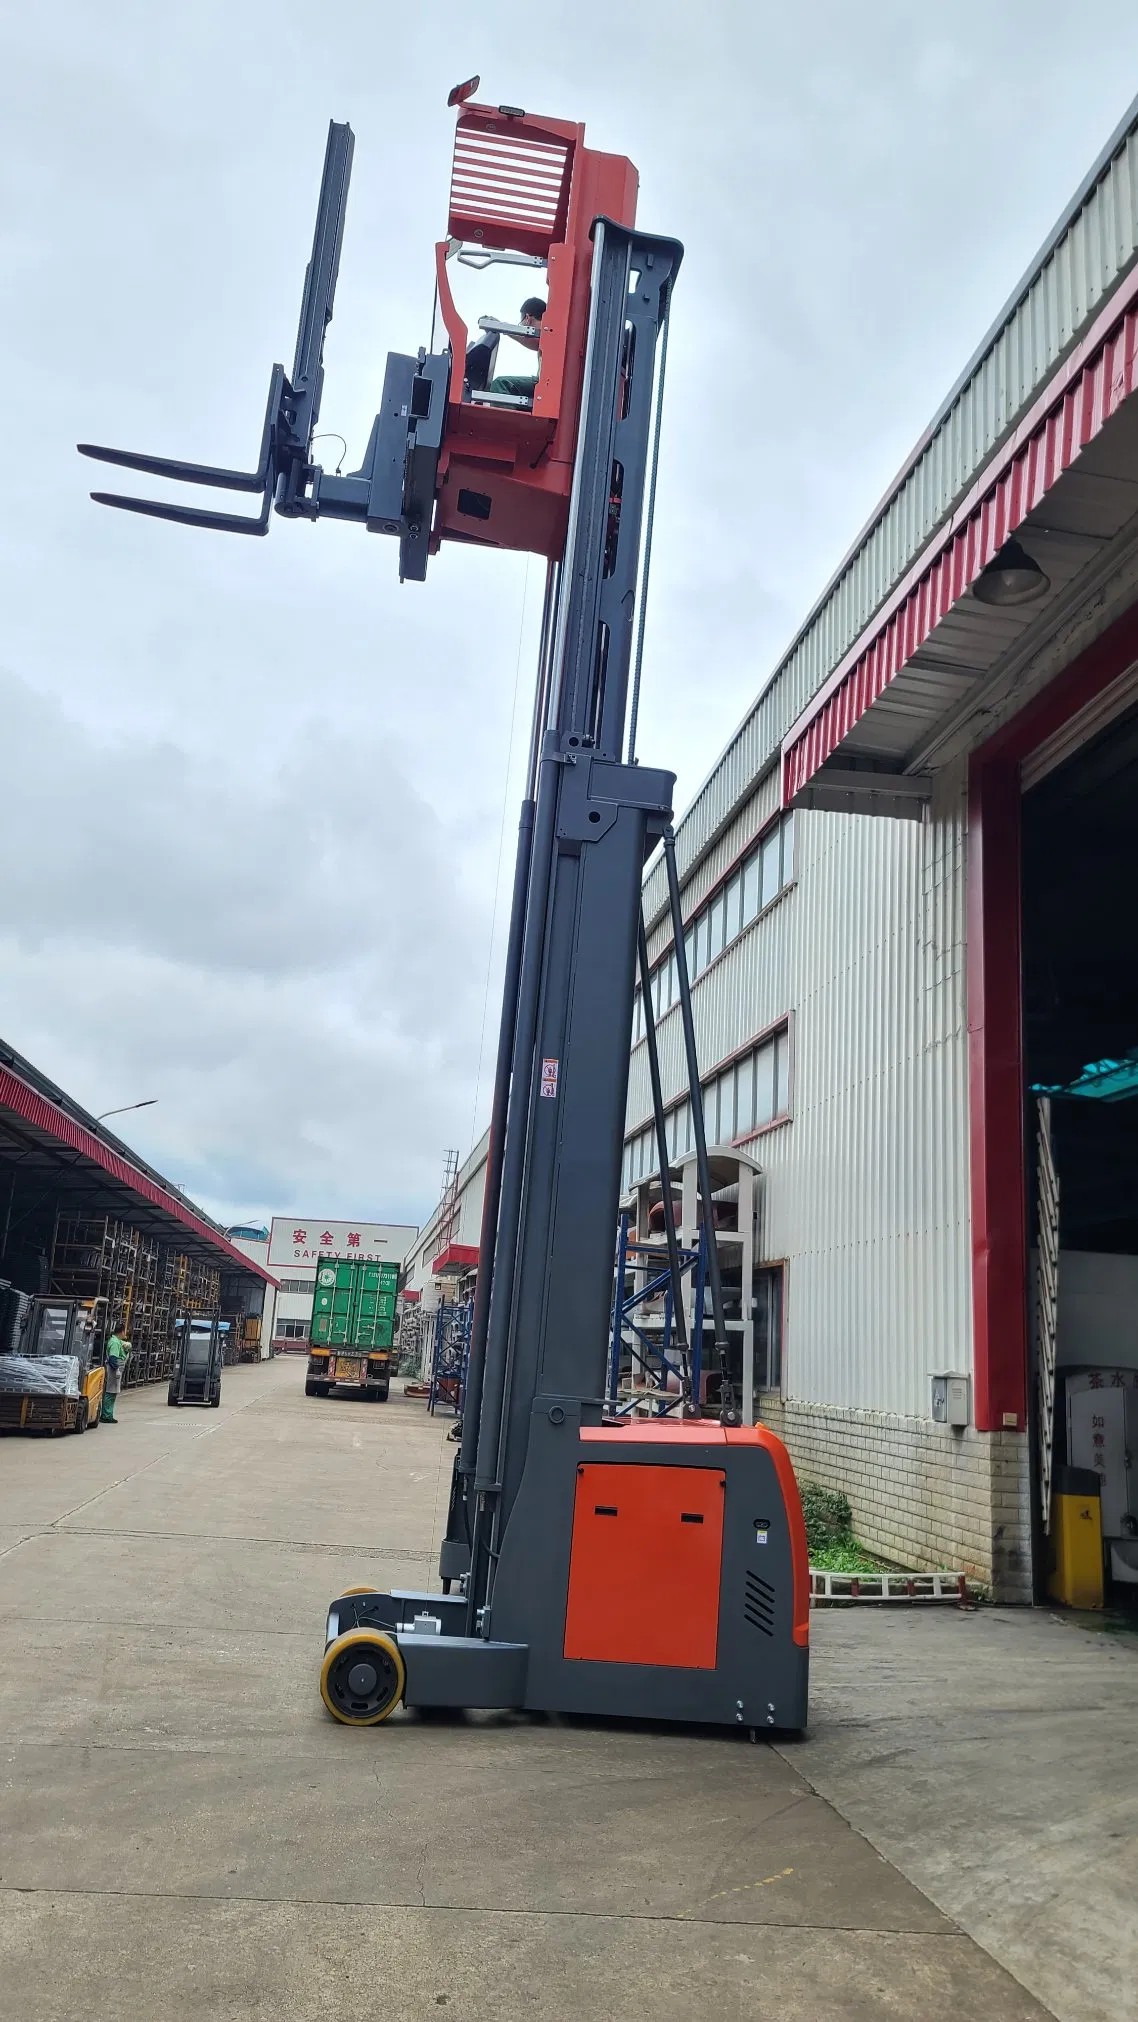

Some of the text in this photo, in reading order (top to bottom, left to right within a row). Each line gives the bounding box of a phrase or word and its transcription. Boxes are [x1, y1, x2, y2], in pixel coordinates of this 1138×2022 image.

[293, 1228, 388, 1248] 安全第一
[293, 1249, 382, 1262] SAFETY FIRST
